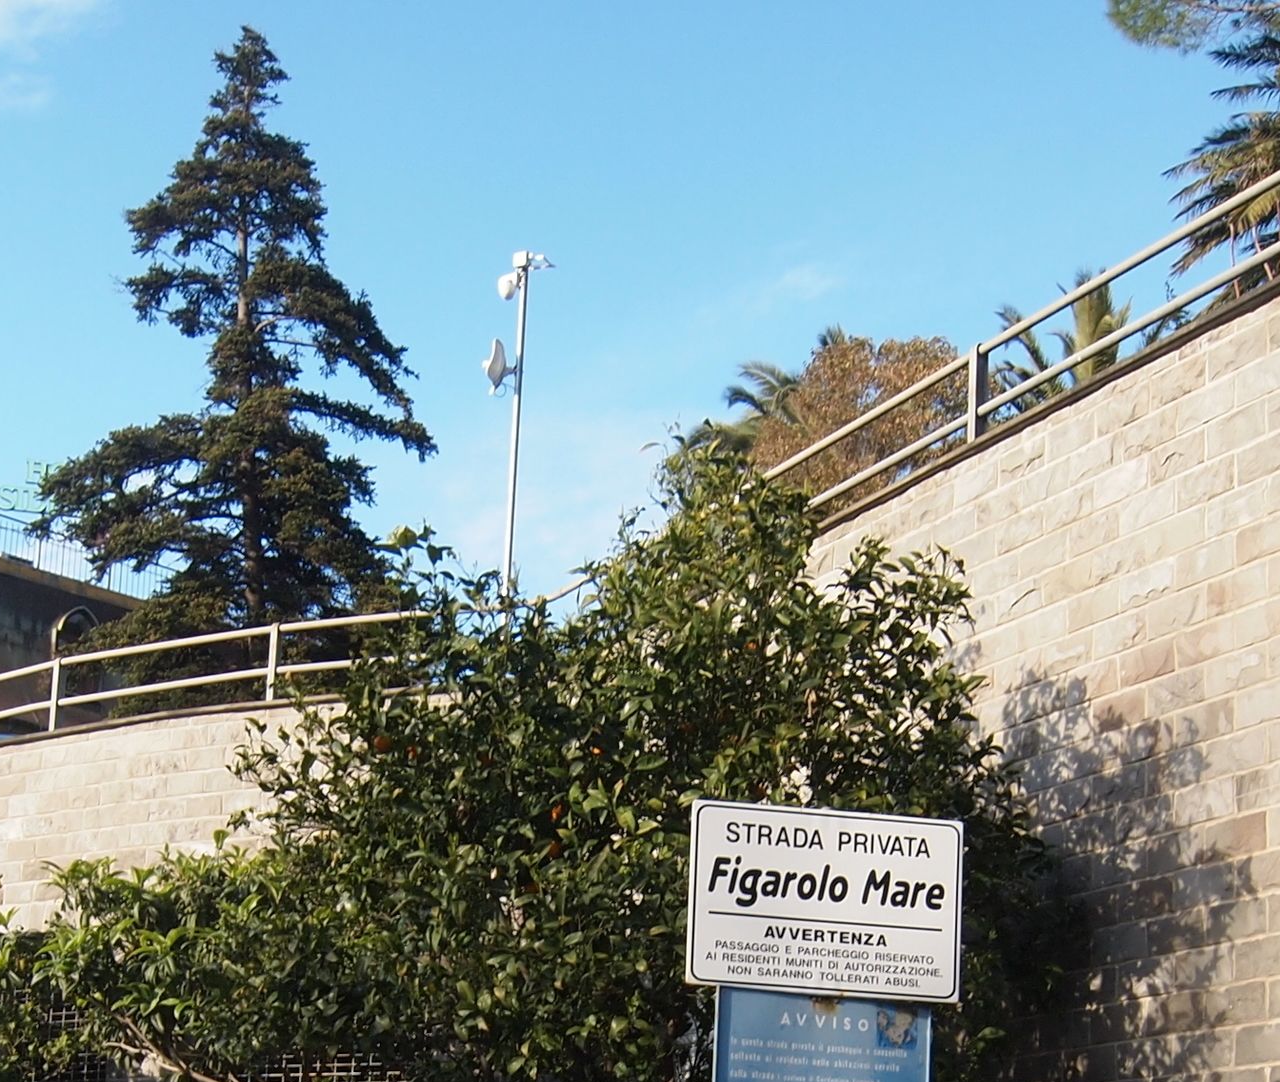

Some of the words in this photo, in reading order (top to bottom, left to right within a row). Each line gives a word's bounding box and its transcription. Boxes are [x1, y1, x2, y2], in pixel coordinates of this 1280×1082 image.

[726, 822, 823, 850] STRADA
[838, 831, 931, 858] PRIVATA
[708, 856, 849, 907] Figarolo
[862, 869, 945, 910] Mare
[764, 926, 888, 947] AVVERTENZA
[705, 952, 717, 961] AI
[722, 953, 780, 965] RESIDENTI
[785, 958, 823, 968] MUNITI
[828, 961, 838, 969] DI
[844, 962, 943, 977] AUTORIZZAZIONE.
[715, 940, 779, 953] PASSAGGIO
[785, 946, 791, 954] E
[798, 946, 869, 961] PARCHEGGIO
[875, 953, 935, 965] RISERVATO
[727, 965, 752, 976] NON
[757, 967, 813, 980] SARANNO
[820, 972, 879, 985] TOLLERATI
[885, 977, 920, 988] ABUSI.
[780, 1012, 869, 1032] AVVISO
